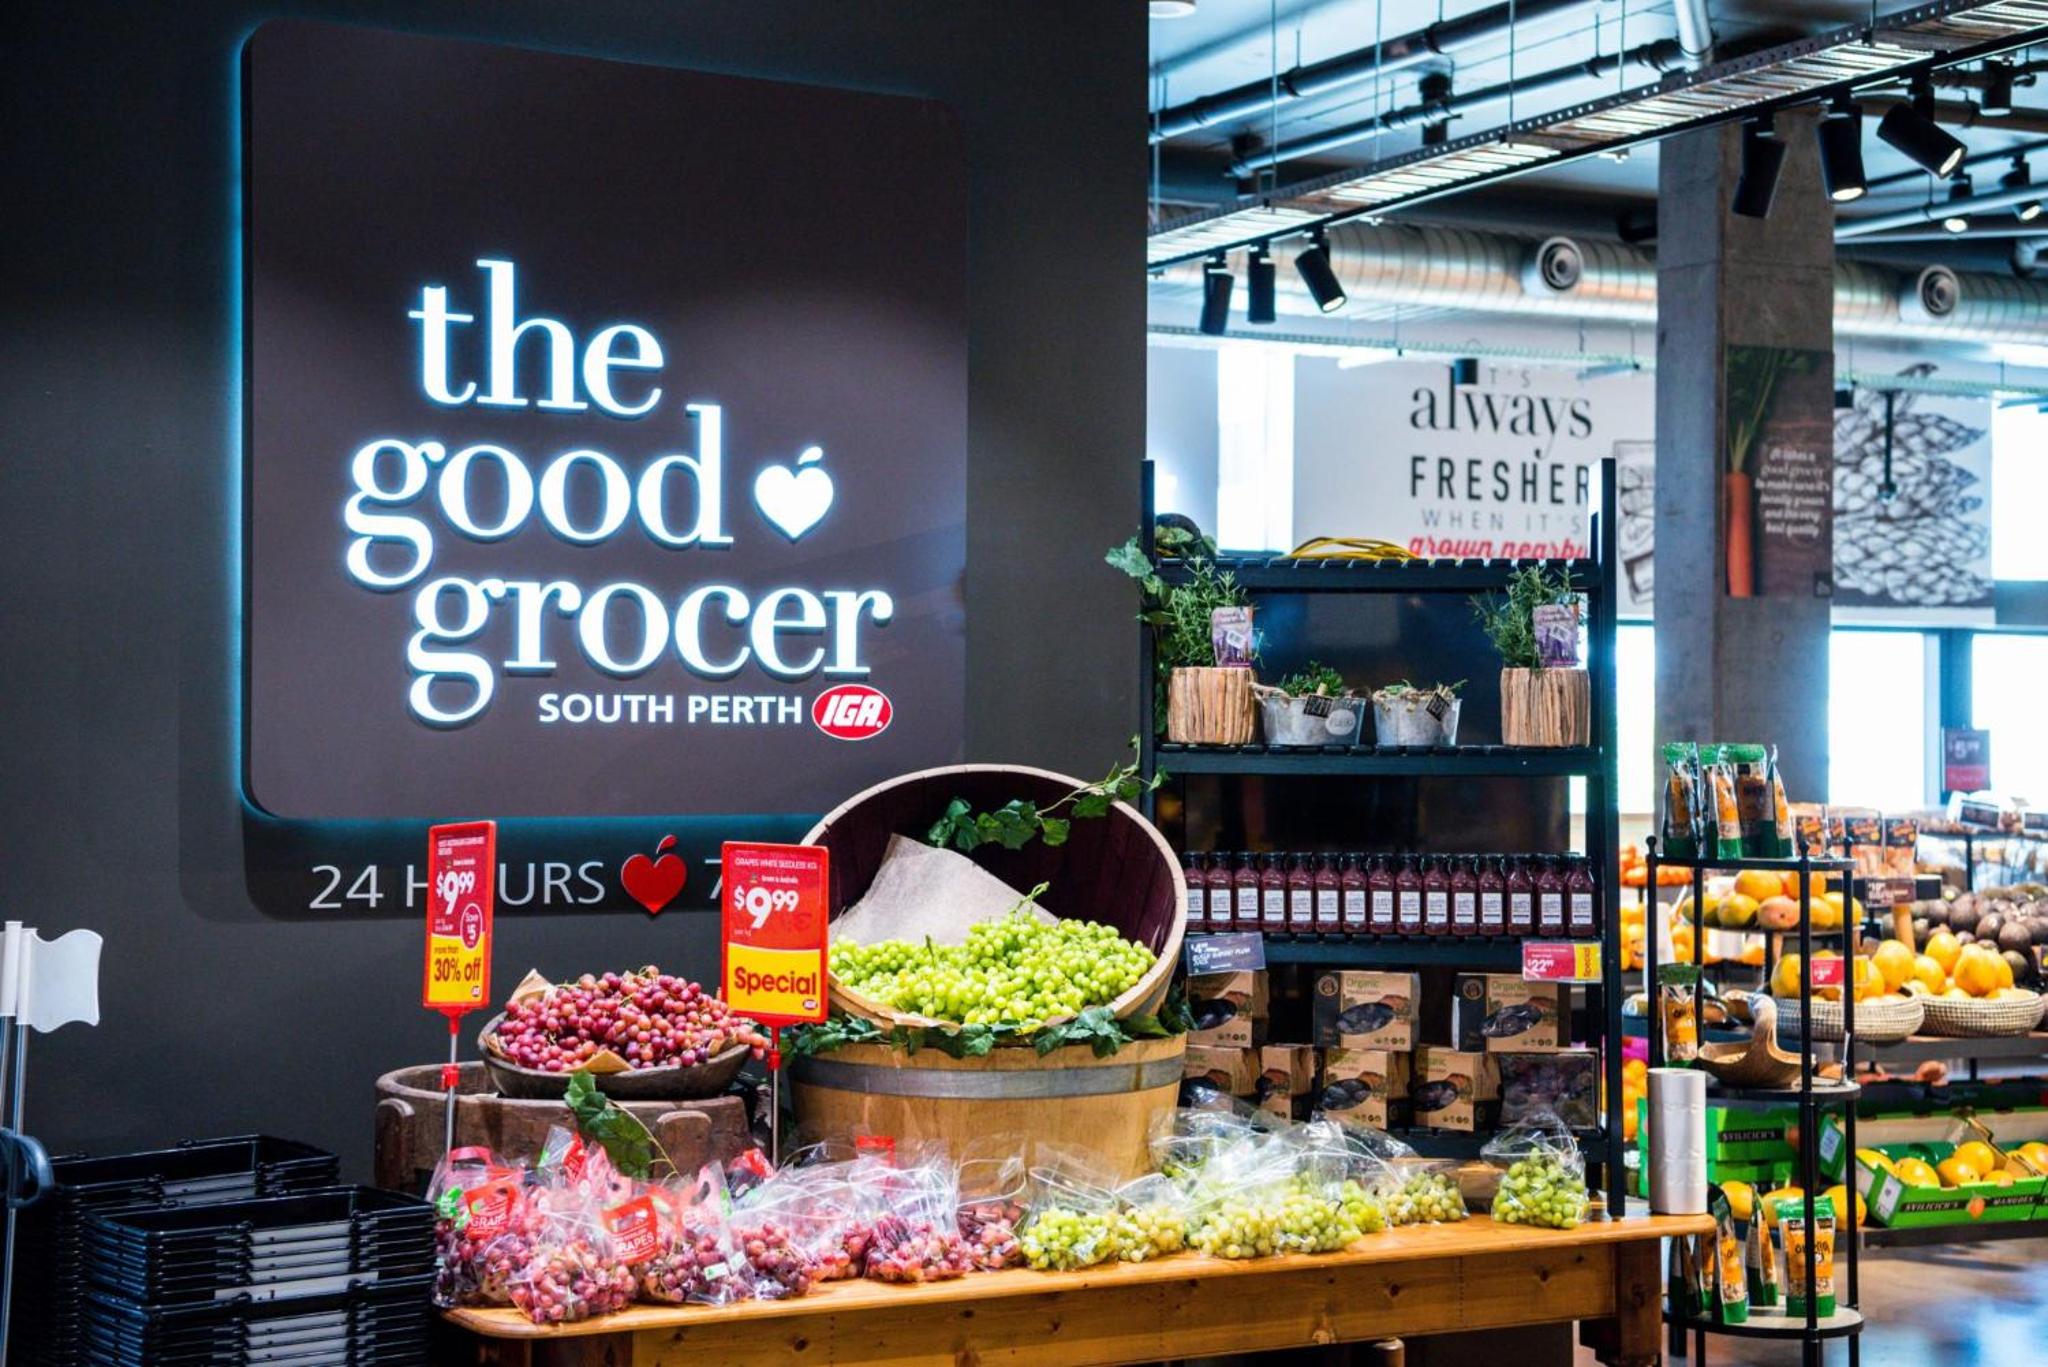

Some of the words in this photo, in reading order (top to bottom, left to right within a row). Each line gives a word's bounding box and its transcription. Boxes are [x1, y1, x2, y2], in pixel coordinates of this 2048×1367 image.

[408, 259, 665, 416] the
[1489, 368, 1532, 388] T'S
[1410, 366, 1593, 460] always
[344, 403, 733, 587] good
[1410, 455, 1590, 506] FRESHER
[1422, 510, 1504, 531] WHEN
[1525, 514, 1582, 535] IT'S
[407, 577, 893, 723] grocer
[538, 693, 674, 724] SOUTH
[687, 694, 802, 725] PERTH
[308, 864, 384, 909] 24
[406, 862, 606, 909] HURS
[434, 957, 461, 982] 30%
[464, 957, 481, 982] off
[734, 966, 817, 996] Special
